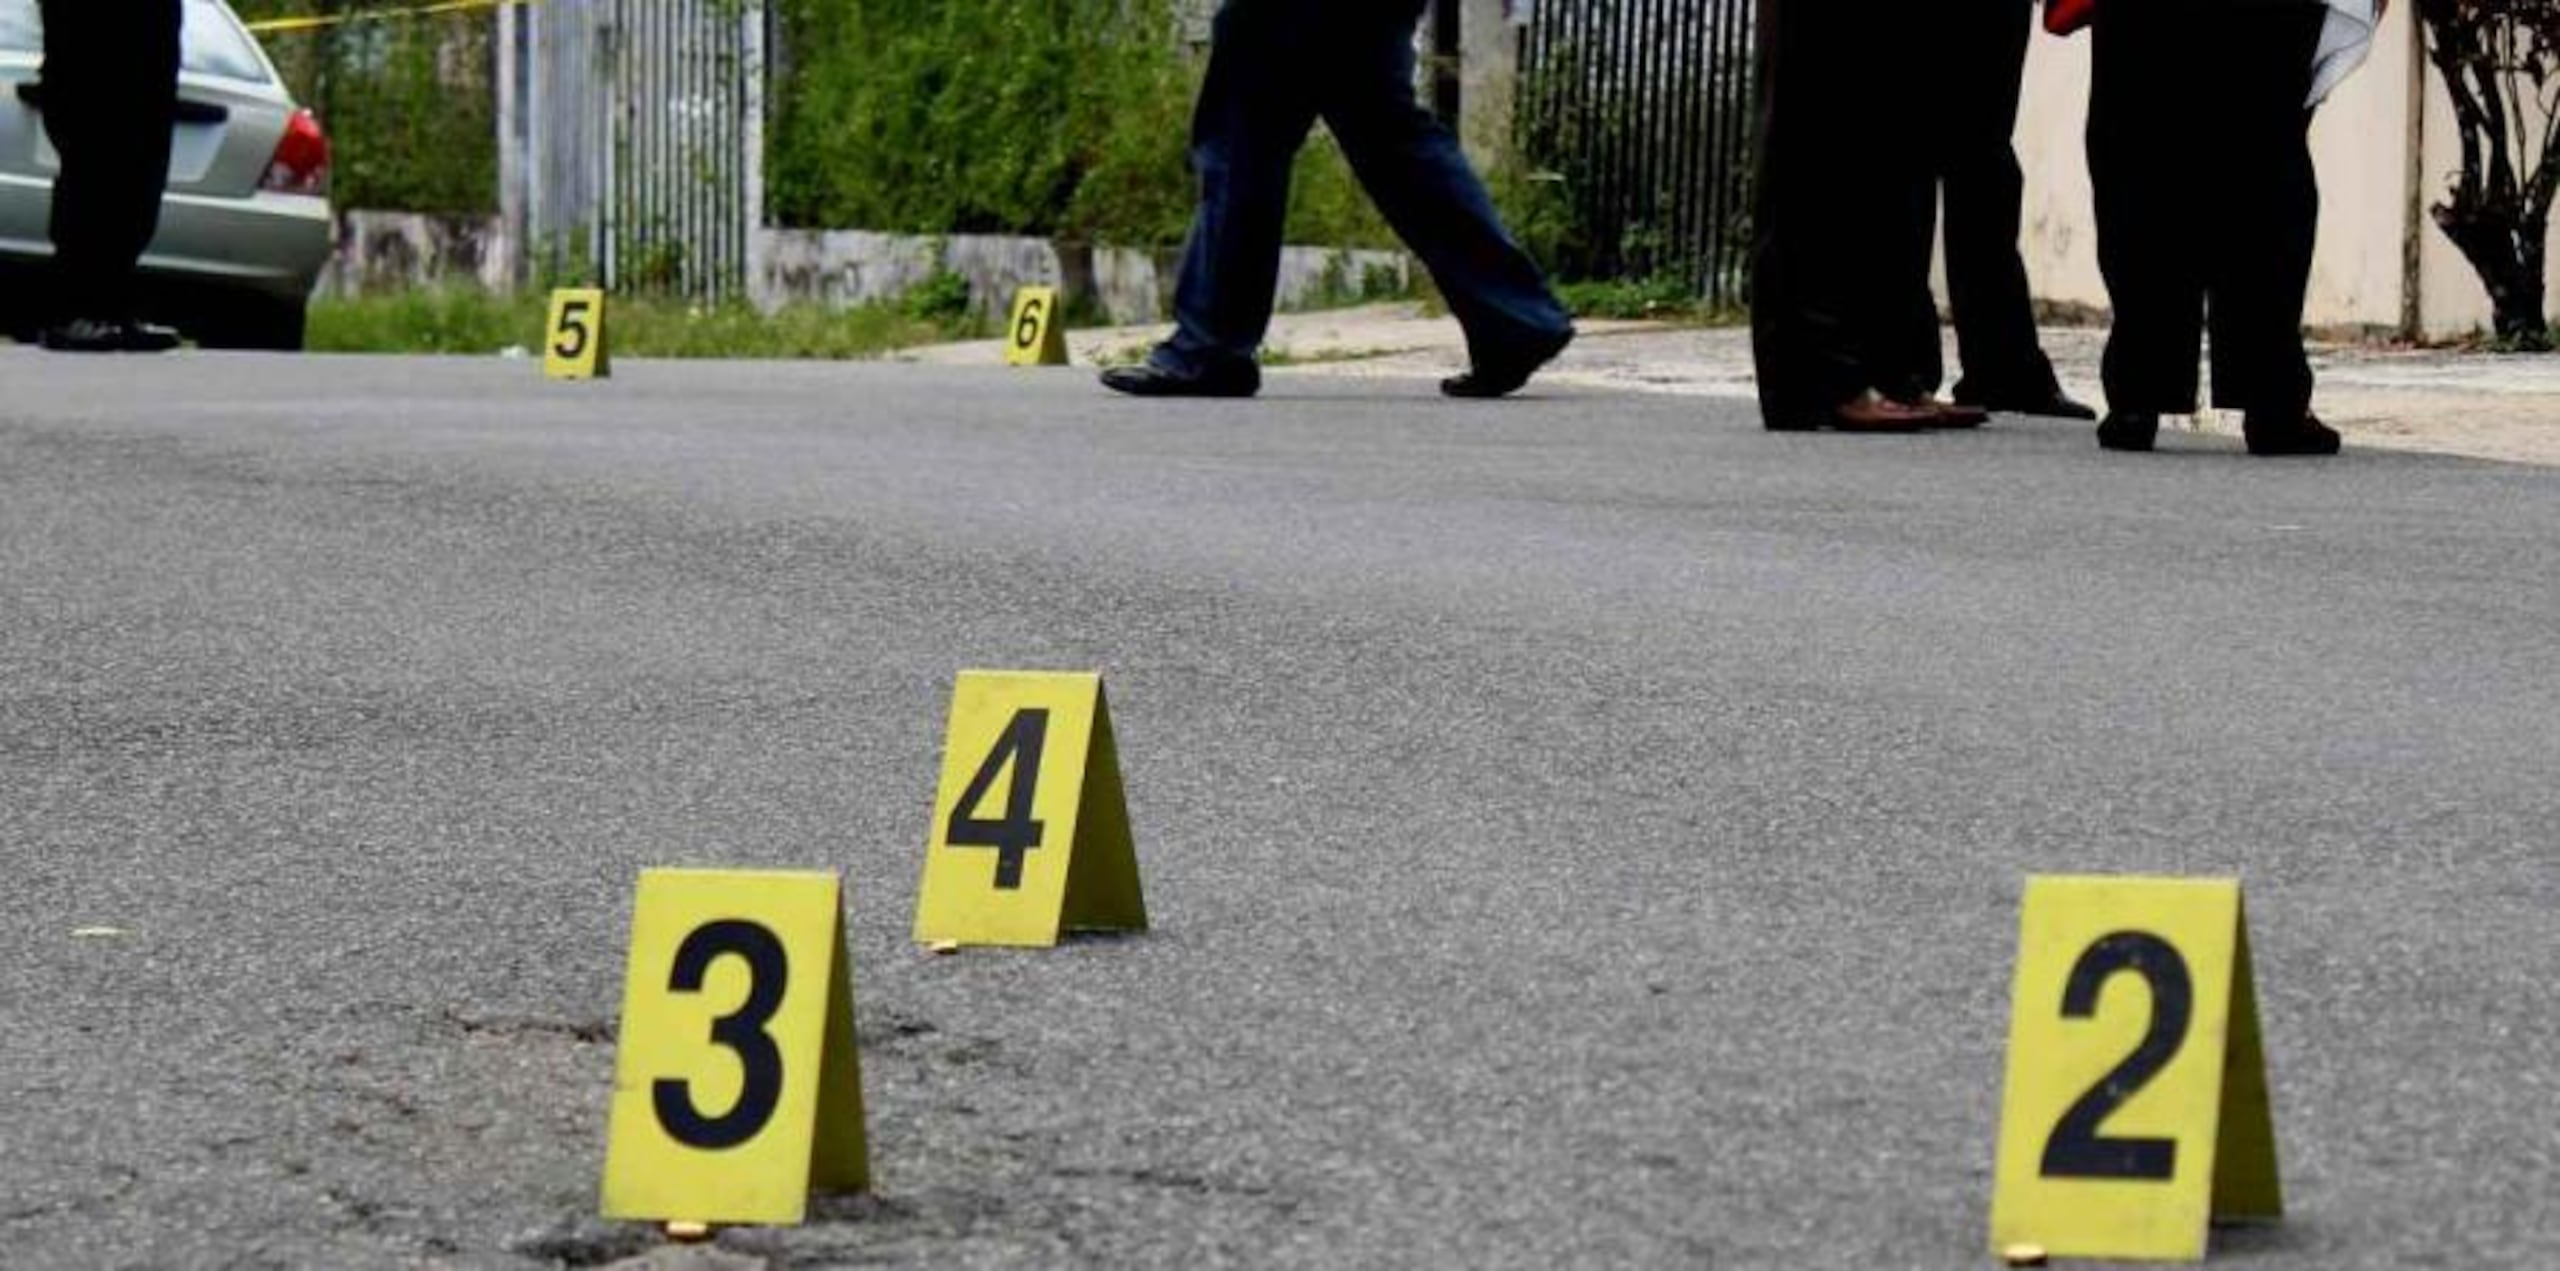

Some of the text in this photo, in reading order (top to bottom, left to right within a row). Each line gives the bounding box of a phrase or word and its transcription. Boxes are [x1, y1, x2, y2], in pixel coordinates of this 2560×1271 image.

[555, 301, 589, 358] 5
[1016, 299, 1042, 349] 6
[945, 707, 1050, 889] 4
[652, 918, 788, 1150] 3
[2039, 930, 2194, 1179] 2
